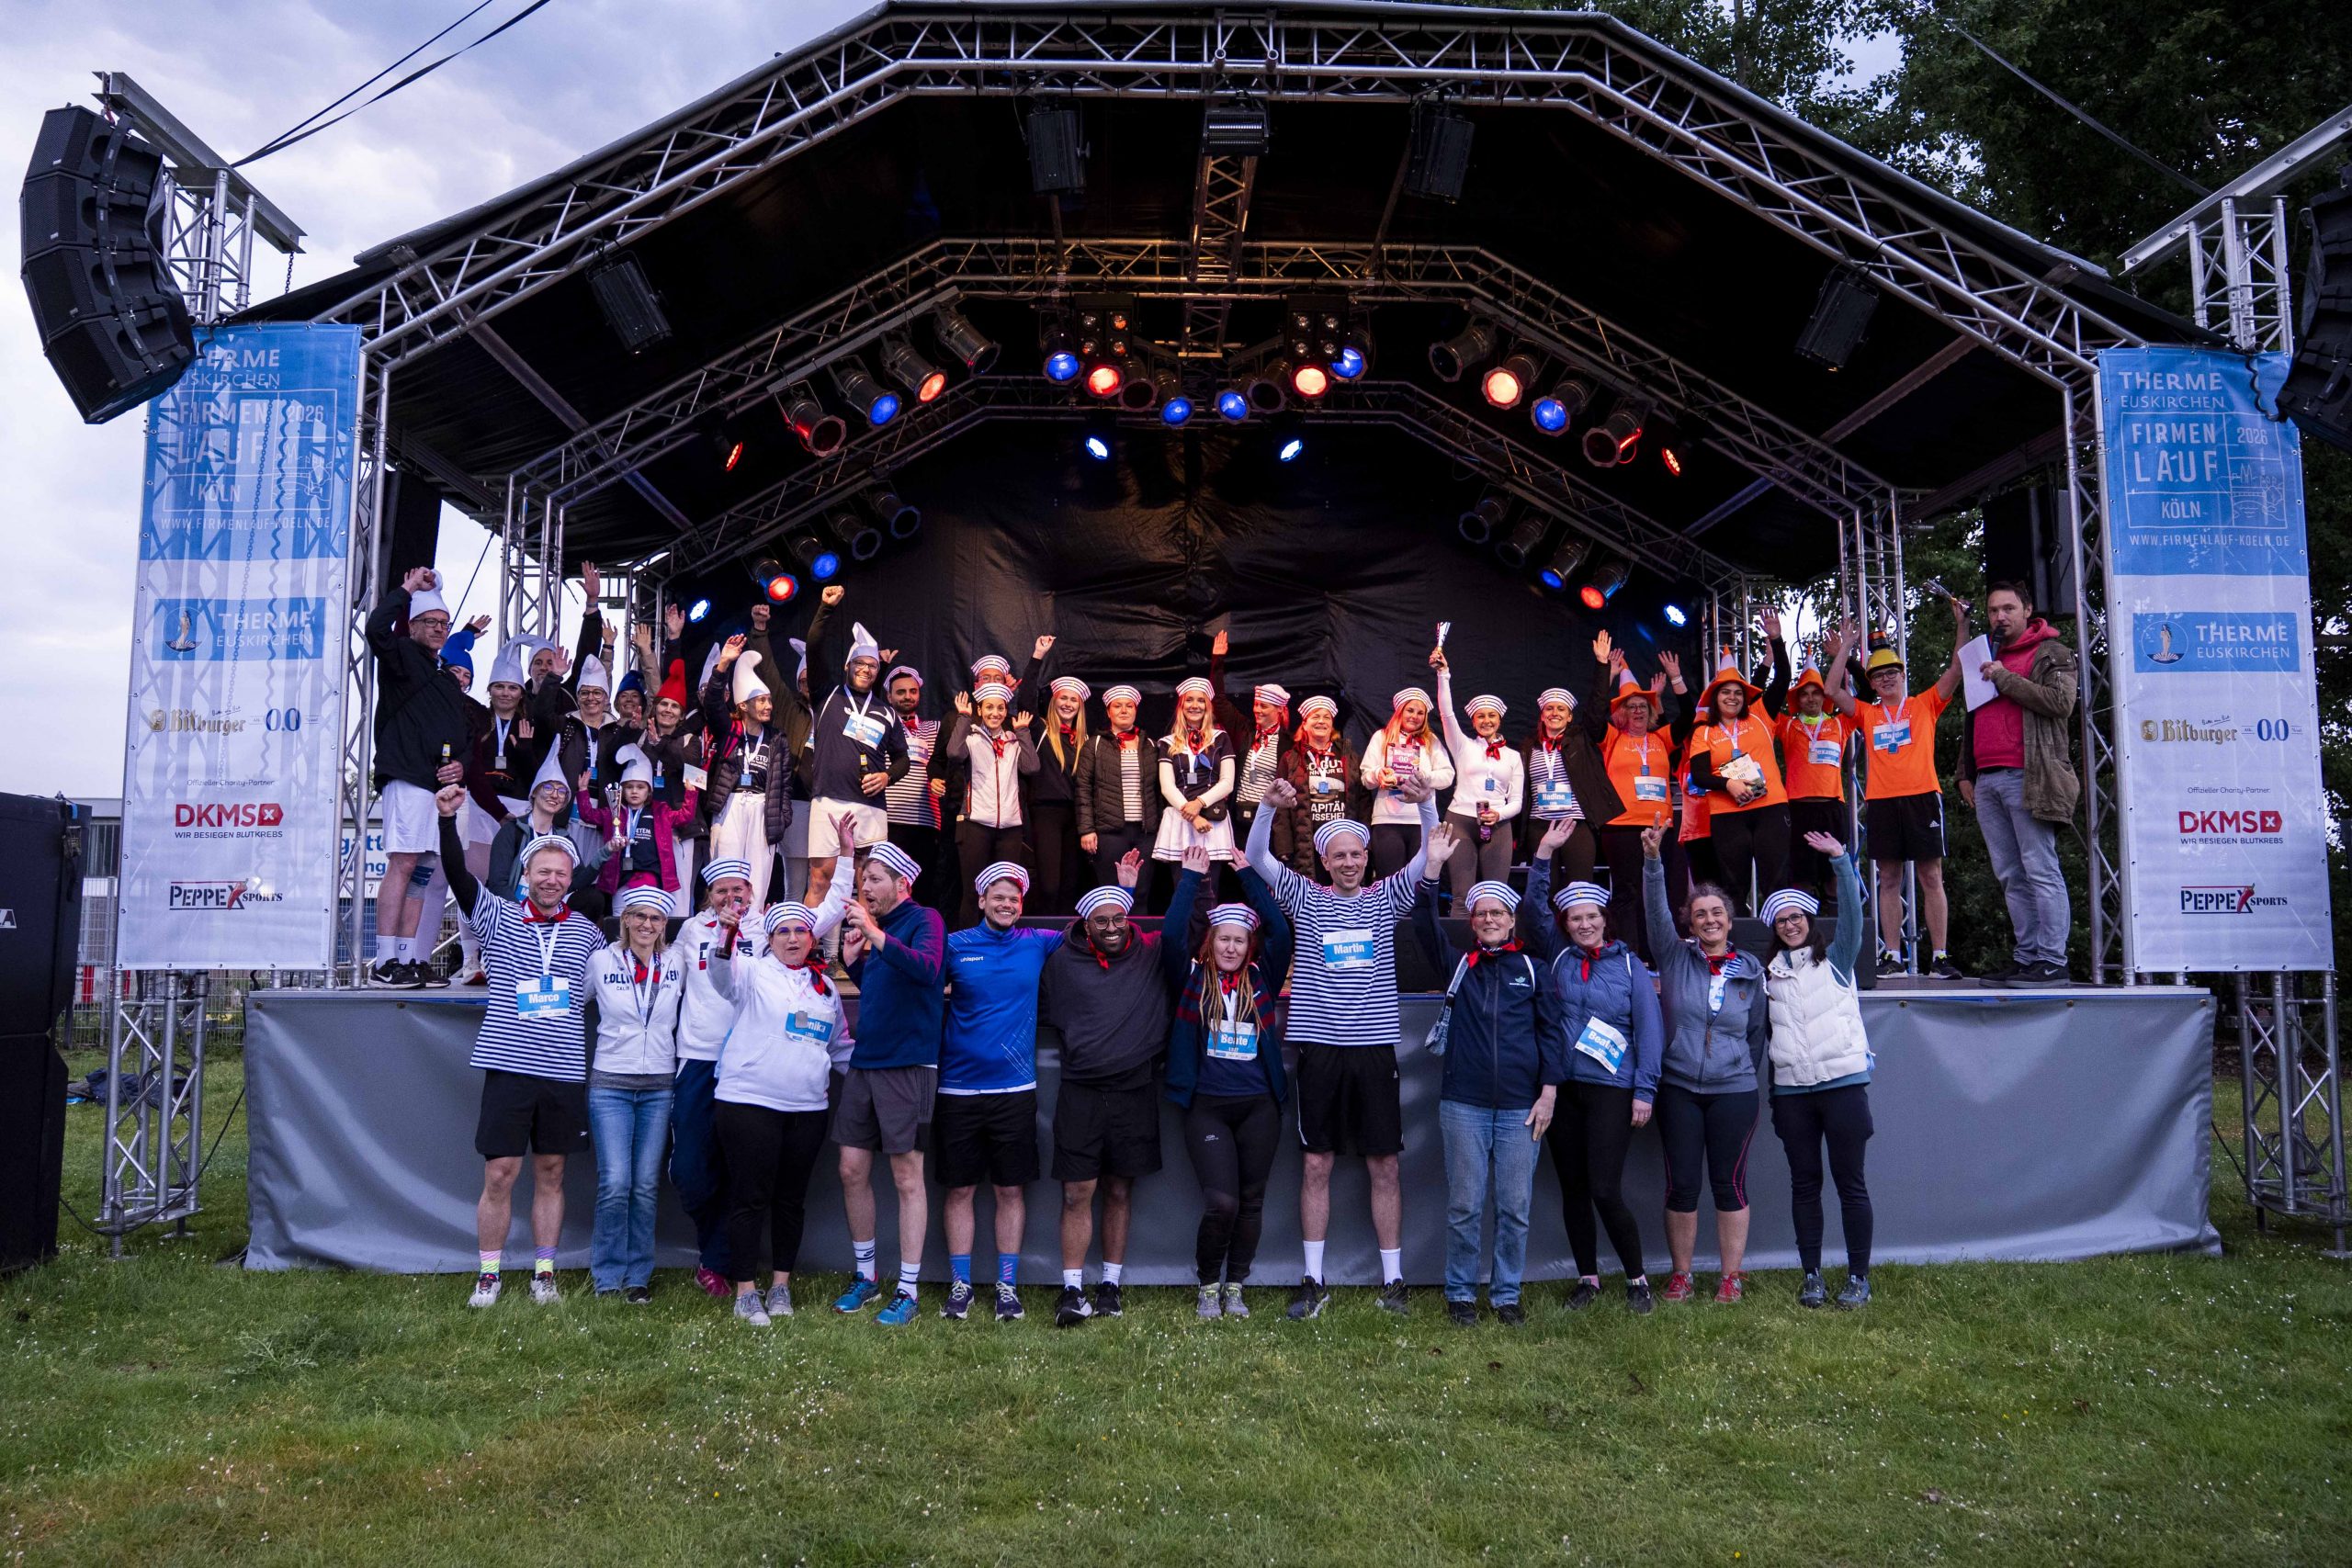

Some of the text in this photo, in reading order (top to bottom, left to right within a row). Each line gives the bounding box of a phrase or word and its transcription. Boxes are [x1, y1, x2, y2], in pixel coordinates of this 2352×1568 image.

[179, 373, 280, 386] USKIRCHEN
[2118, 371, 2223, 390] THERME
[2120, 395, 2225, 409] EUSKIRCHEN
[180, 401, 267, 424] FIRMEN
[287, 405, 324, 423] 2026
[2132, 423, 2217, 445] FIRMEN
[2236, 426, 2268, 446] 2026
[177, 430, 266, 465] LAUF
[2133, 450, 2218, 483] LAUF
[198, 479, 241, 502] KÖLN
[2161, 498, 2201, 519] KÖLN
[2129, 535, 2290, 547] WWW.FIRMENLAUF-KOELN.DE
[218, 611, 312, 630] THERME
[216, 633, 312, 647] EUSKIRCHEN
[2195, 624, 2289, 642] THERME
[2197, 647, 2290, 659] EUSKIRCHEN
[169, 708, 247, 736] Bitburger
[266, 707, 301, 732] 0.0
[2256, 718, 2290, 741] 0.0
[2161, 718, 2238, 745] Bitburger
[175, 804, 257, 828] DKMS
[2178, 810, 2259, 834] DKMS
[2250, 897, 2288, 906] SPORTS
[1333, 942, 1365, 955] Martin
[528, 993, 560, 1004] Marco
[1588, 1030, 1620, 1059] Beatrice
